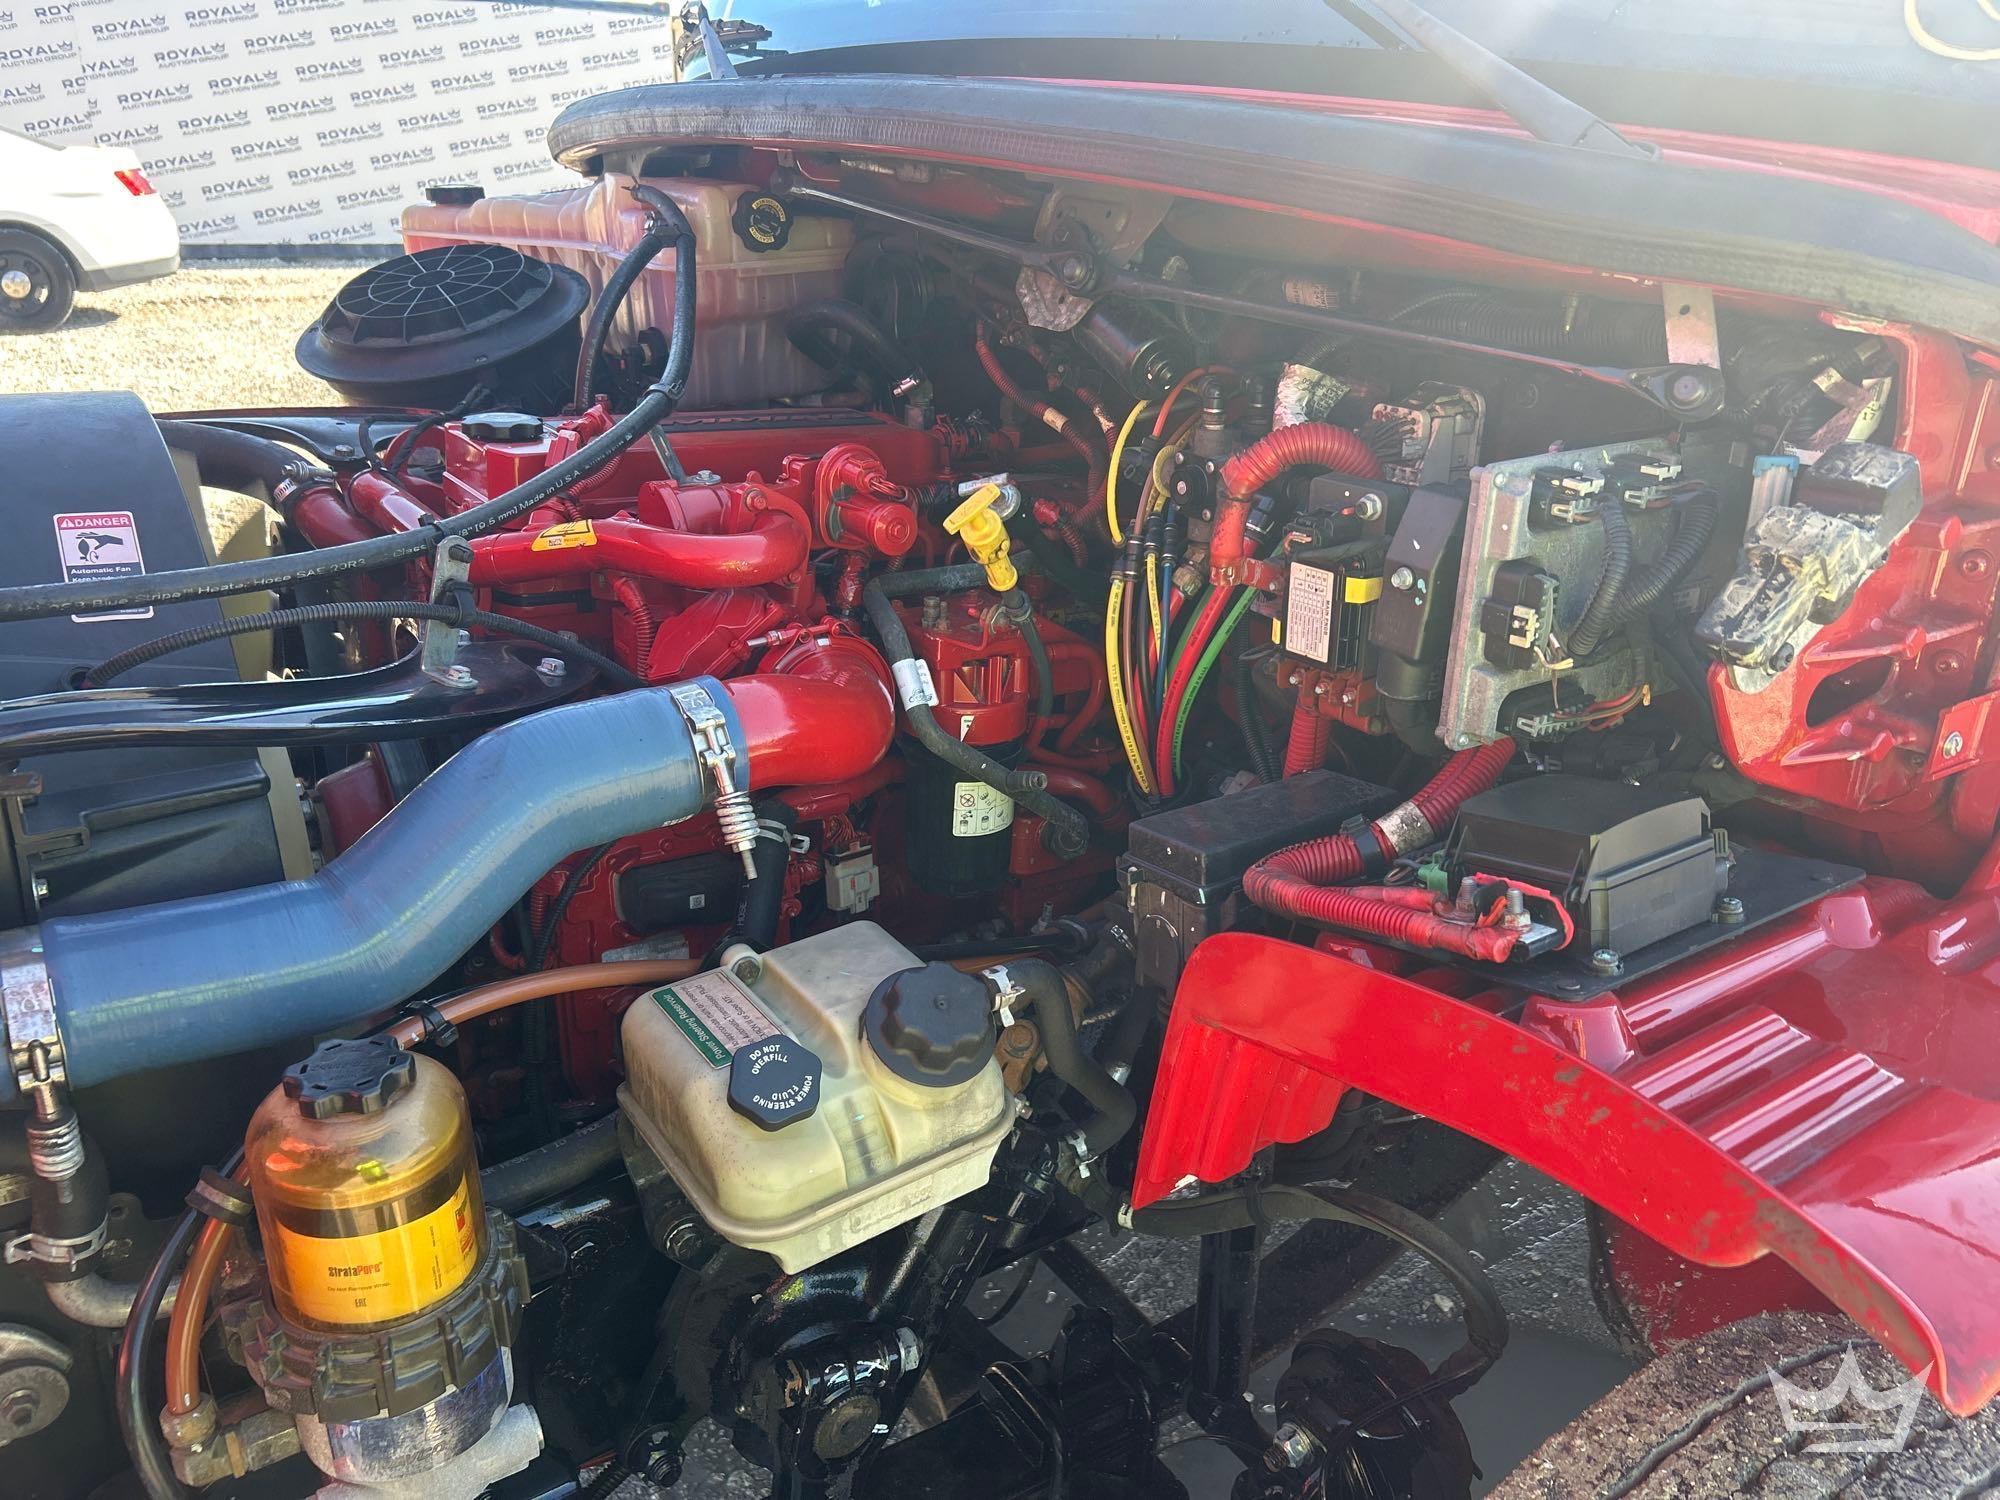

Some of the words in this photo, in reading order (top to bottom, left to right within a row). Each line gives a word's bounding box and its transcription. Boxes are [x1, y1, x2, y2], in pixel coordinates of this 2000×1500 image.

[184, 6, 242, 22] ROYAL
[190, 18, 228, 28] AUCTION
[229, 12, 260, 23] GROUP
[412, 10, 464, 24] ROYAL
[91, 17, 151, 34] ROYAL
[330, 21, 383, 36] ROYAL
[416, 22, 450, 31] AUCTION
[608, 16, 653, 30] ROYAL
[97, 31, 136, 41] AUCTION
[138, 26, 169, 36] GROUP
[244, 32, 300, 48] ROYAL
[334, 33, 370, 43] AUCTION
[536, 26, 583, 42] ROYAL
[0, 44, 58, 60] ROYAL
[248, 46, 286, 56] AUCTION
[286, 40, 316, 50] GROUP
[459, 36, 510, 52] ROYAL
[1, 57, 43, 68] AUCTION
[44, 52, 77, 62] GROUP
[154, 45, 212, 62] ROYAL
[158, 58, 197, 69] AUCTION
[198, 52, 229, 63] GROUP
[379, 48, 432, 64] ROYAL
[582, 52, 628, 66] ROYAL
[107, 67, 139, 77] GROUP
[295, 60, 350, 76] ROYAL
[382, 60, 417, 70] AUCTION
[508, 62, 556, 78] ROYAL
[208, 73, 264, 90] ROYAL
[299, 73, 336, 82] AUCTION
[430, 73, 481, 89] ROYAL
[117, 85, 173, 104] ROYAL
[212, 86, 250, 96] AUCTION
[251, 80, 281, 90] GROUP
[350, 86, 402, 102] ROYAL
[552, 87, 597, 102] ROYAL
[122, 100, 160, 111] AUCTION
[162, 94, 193, 105] GROUP
[266, 98, 320, 115] ROYAL
[354, 98, 388, 108] AUCTION
[477, 99, 525, 115] ROYAL
[24, 115, 86, 132] ROYAL
[178, 114, 234, 130] ROYAL
[270, 112, 307, 122] AUCTION
[398, 112, 450, 127] ROYAL
[182, 125, 220, 136] AUCTION
[221, 119, 251, 130] GROUP
[316, 124, 368, 141] ROYAL
[402, 124, 436, 134] AUCTION
[132, 135, 163, 144] GROUP
[231, 139, 286, 156] ROYAL
[320, 138, 356, 148] AUCTION
[449, 135, 498, 152] ROYAL
[235, 152, 272, 162] AUCTION
[273, 146, 302, 156] GROUP
[370, 149, 422, 166] ROYAL
[141, 153, 199, 172] ROYAL
[146, 167, 186, 178] AUCTION
[186, 160, 216, 171] GROUP
[374, 162, 408, 172] AUCTION
[493, 159, 540, 176] ROYAL
[288, 164, 342, 180] ROYAL
[202, 178, 256, 195] ROYAL
[291, 177, 328, 186] AUCTION
[206, 192, 244, 202] AUCTION
[244, 185, 274, 196] GROUP
[337, 188, 388, 205] ROYAL
[253, 202, 307, 220] ROYAL
[340, 201, 376, 210] AUCTION
[257, 216, 294, 226] AUCTION
[294, 209, 323, 220] GROUP
[308, 225, 360, 242] ROYAL
[74, 517, 130, 527] DANGER
[92, 597, 128, 608] Blue
[296, 567, 324, 578] SAE
[520, 492, 546, 511] Made
[546, 486, 556, 496] in
[663, 992, 688, 1020] Reservoir
[704, 991, 731, 1021] Transmission
[685, 1016, 710, 1043] Steering
[705, 1039, 725, 1061] Power
[750, 1049, 762, 1060] DO
[762, 1044, 780, 1054] NOT
[752, 1054, 788, 1075] OVERFILL
[772, 1084, 799, 1100] FLUID
[796, 1075, 813, 1102] POWER
[752, 1095, 796, 1110] STEERING
